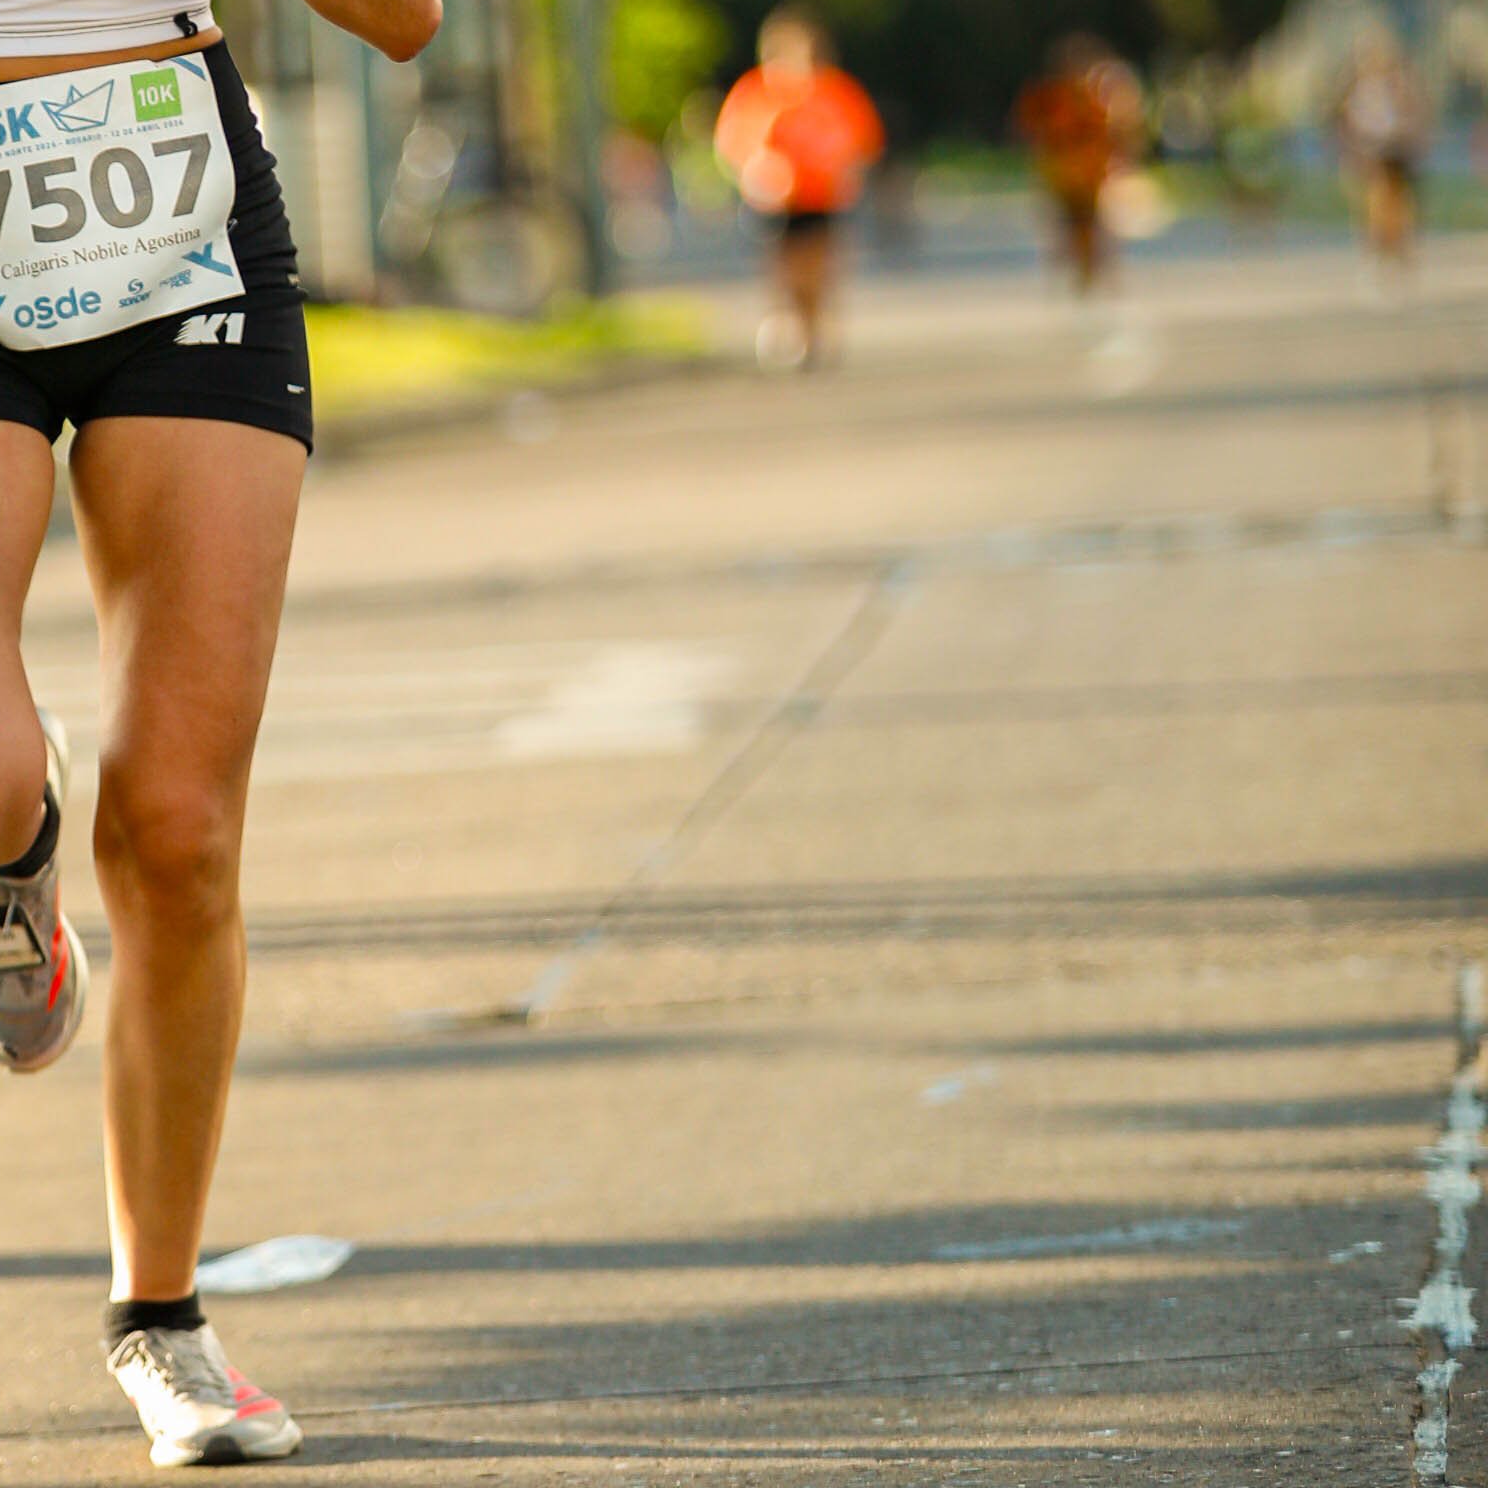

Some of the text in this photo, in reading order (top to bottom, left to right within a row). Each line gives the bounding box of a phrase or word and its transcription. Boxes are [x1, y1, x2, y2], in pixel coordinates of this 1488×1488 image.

[136, 83, 176, 108] 10K
[0, 227, 201, 280] Caligaris Nobile Agostina
[14, 286, 102, 329] osde
[172, 312, 246, 345] K1
